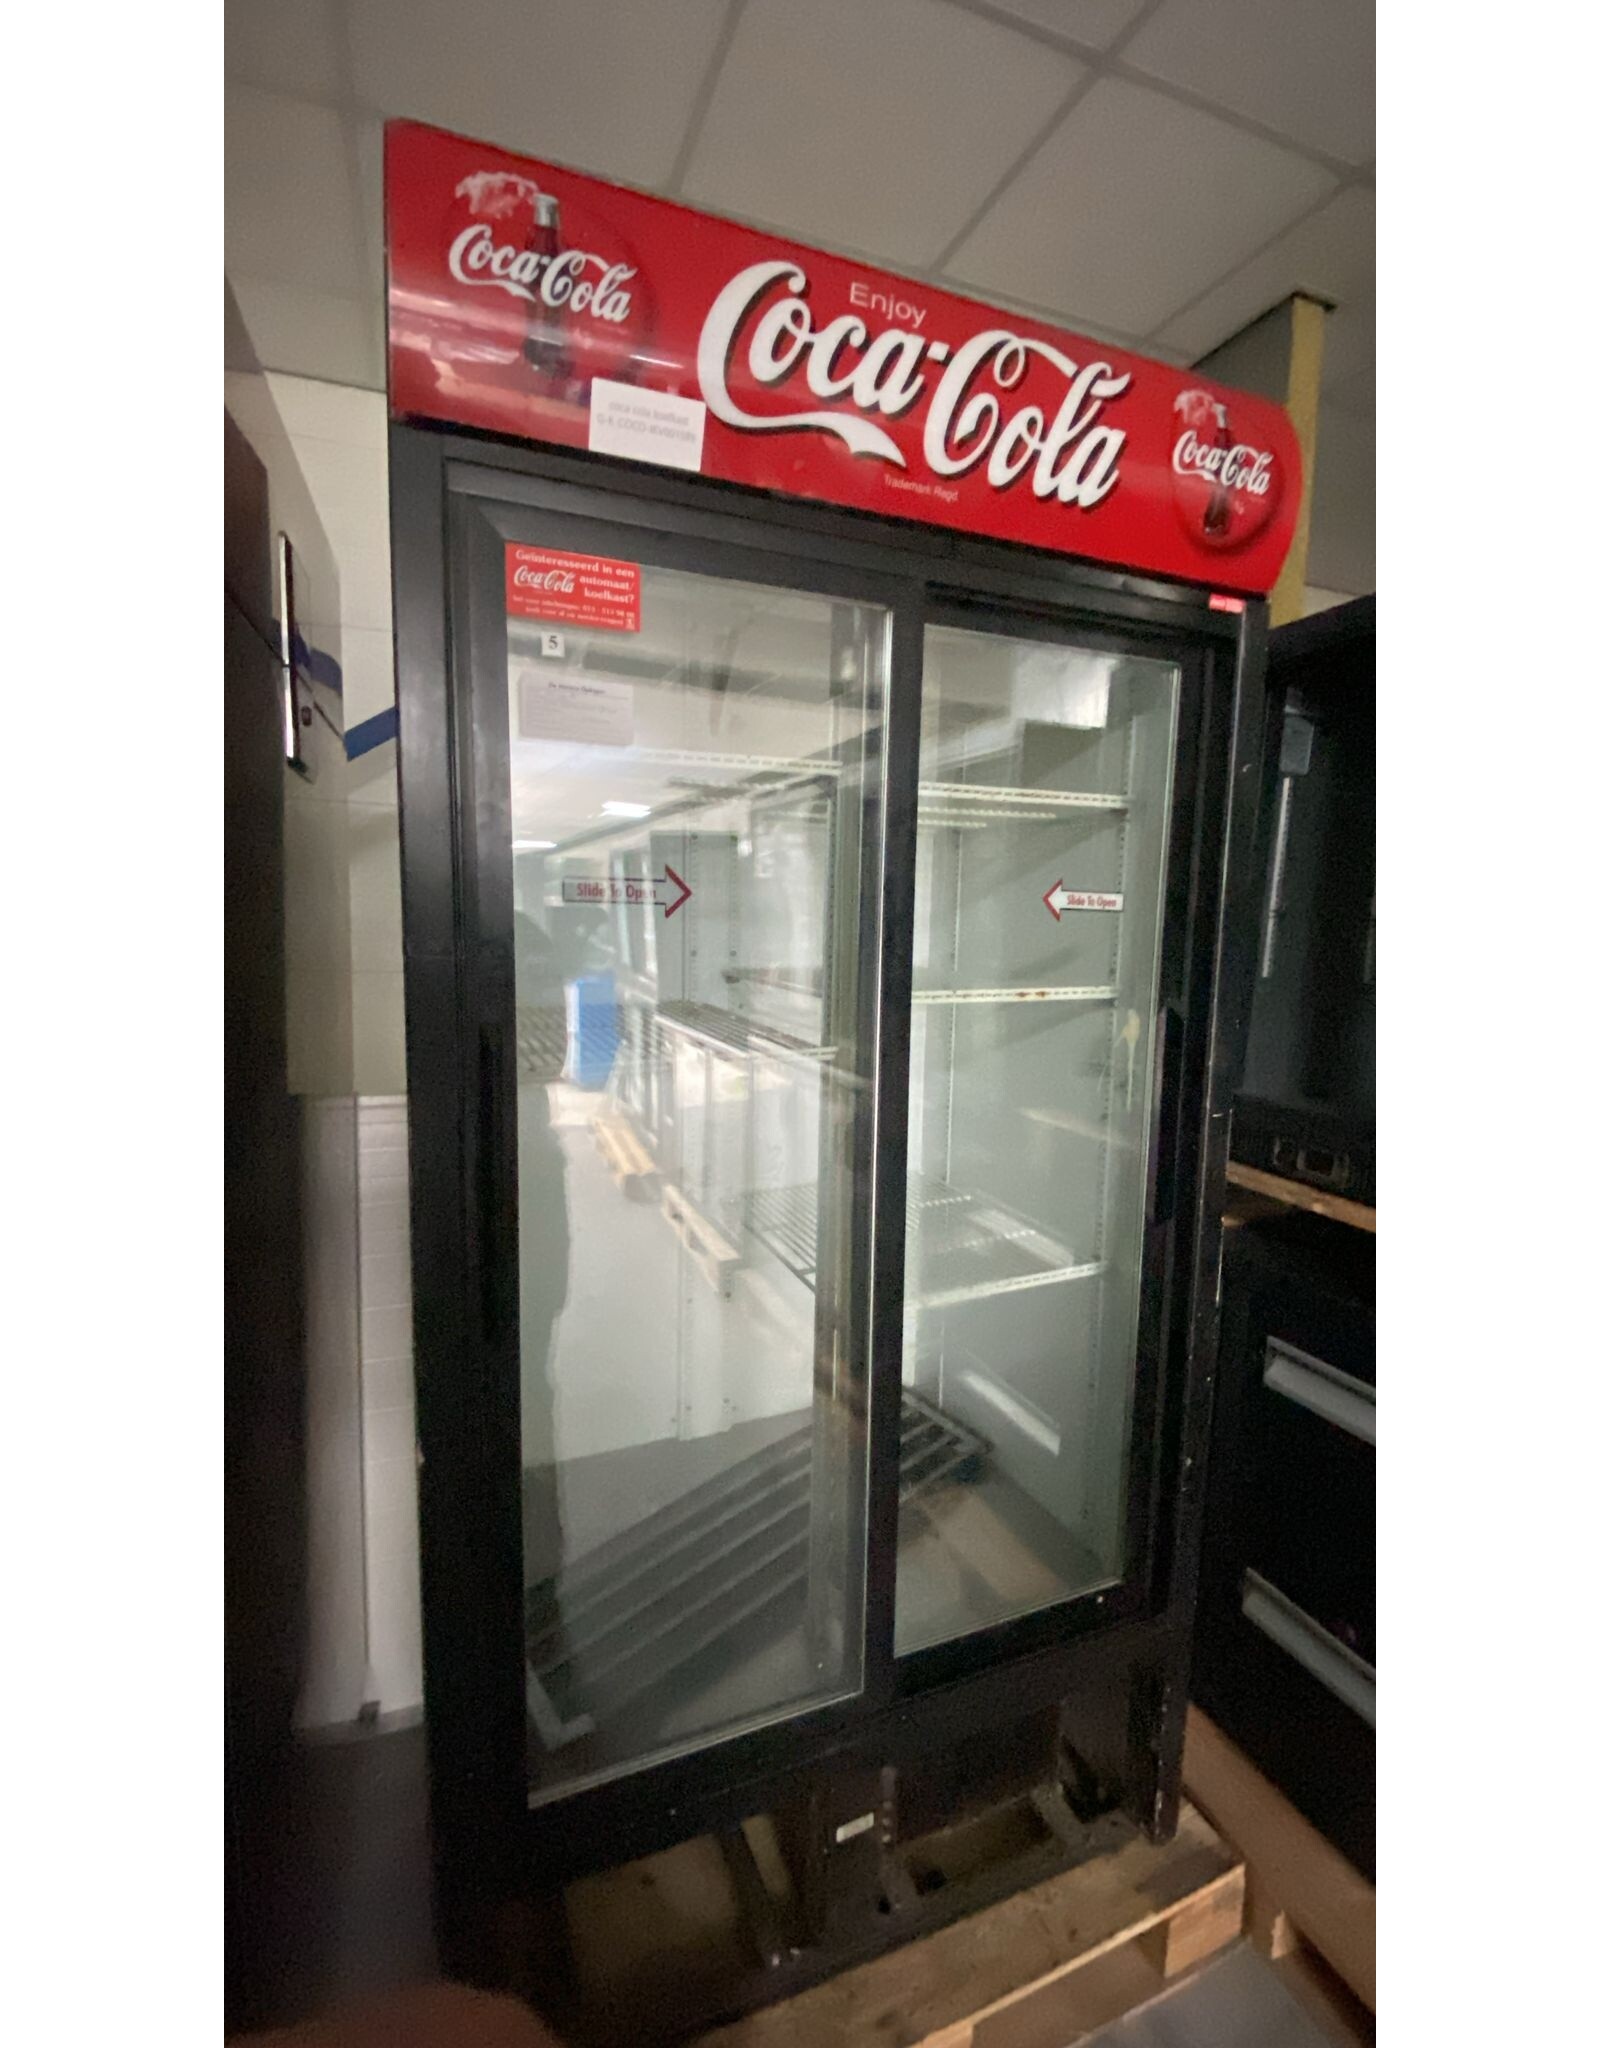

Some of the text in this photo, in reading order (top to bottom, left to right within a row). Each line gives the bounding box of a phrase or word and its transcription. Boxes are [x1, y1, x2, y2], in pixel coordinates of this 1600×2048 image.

[449, 224, 637, 323] Coca-Cola
[850, 282, 927, 329] Enjoy
[697, 260, 1131, 508] Coca-Cola
[1172, 430, 1273, 495] Coca-Cola
[513, 564, 577, 594] Coca-Cola
[602, 563, 613, 574] in
[616, 567, 635, 579] een
[584, 586, 635, 605] koelkast?
[548, 635, 559, 651] 5
[576, 882, 606, 898] Slide
[1067, 894, 1086, 906] Slide
[1097, 896, 1117, 909] Open
